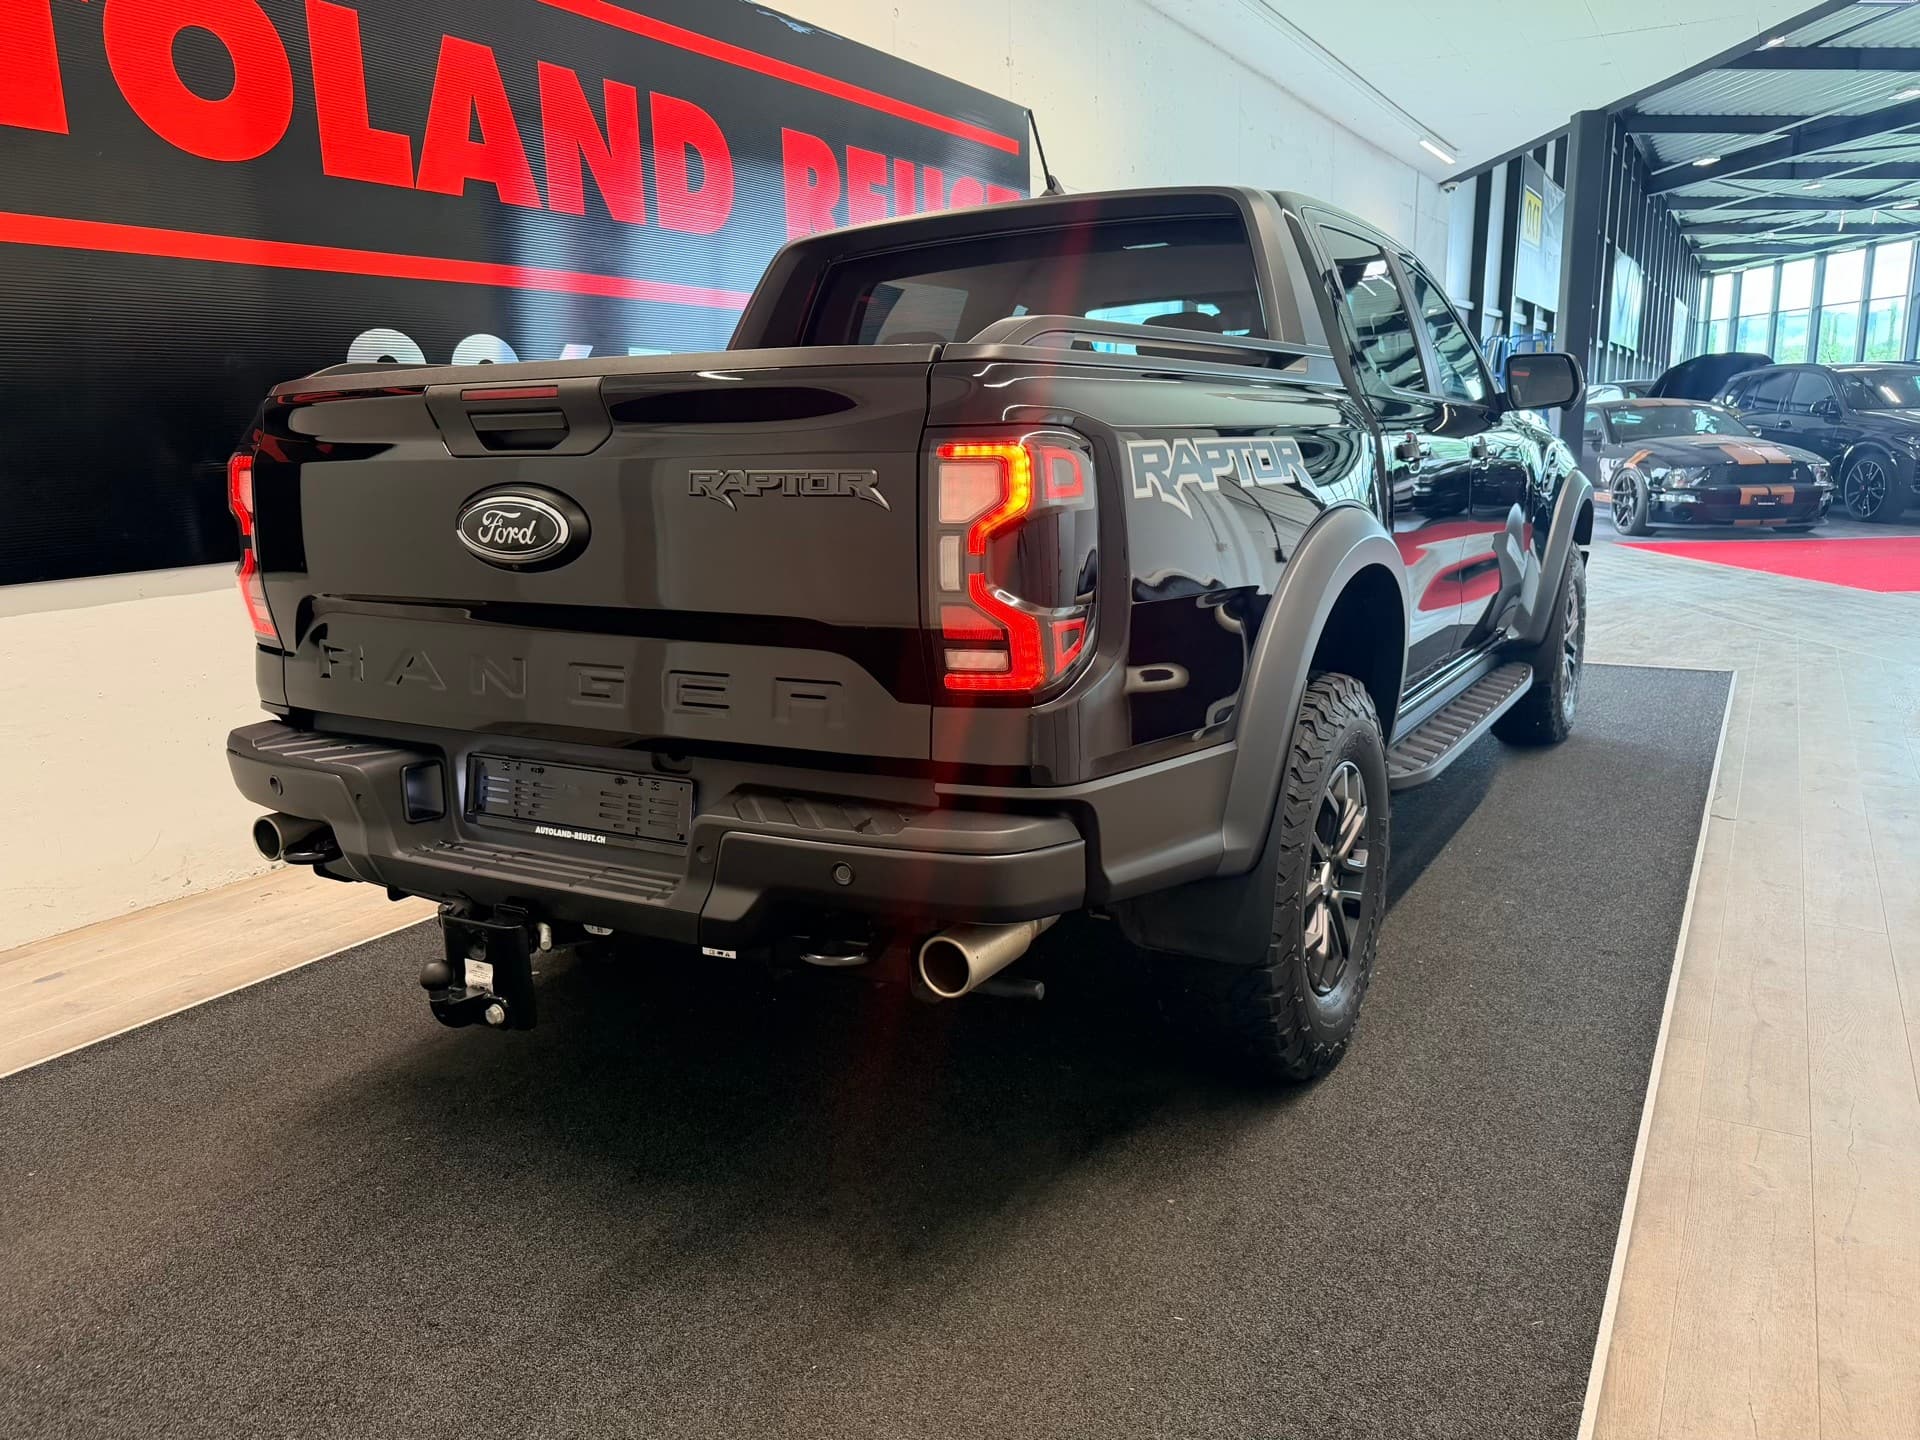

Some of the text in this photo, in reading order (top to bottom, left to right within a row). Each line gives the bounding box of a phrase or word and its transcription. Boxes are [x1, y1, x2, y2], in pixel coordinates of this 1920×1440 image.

[688, 468, 891, 511] RAPTOR
[1127, 436, 1330, 519] RAPTOR
[478, 509, 537, 545] Ford
[318, 641, 847, 730] RANGER
[535, 825, 606, 844] AUTOLAND-REUST.CH
